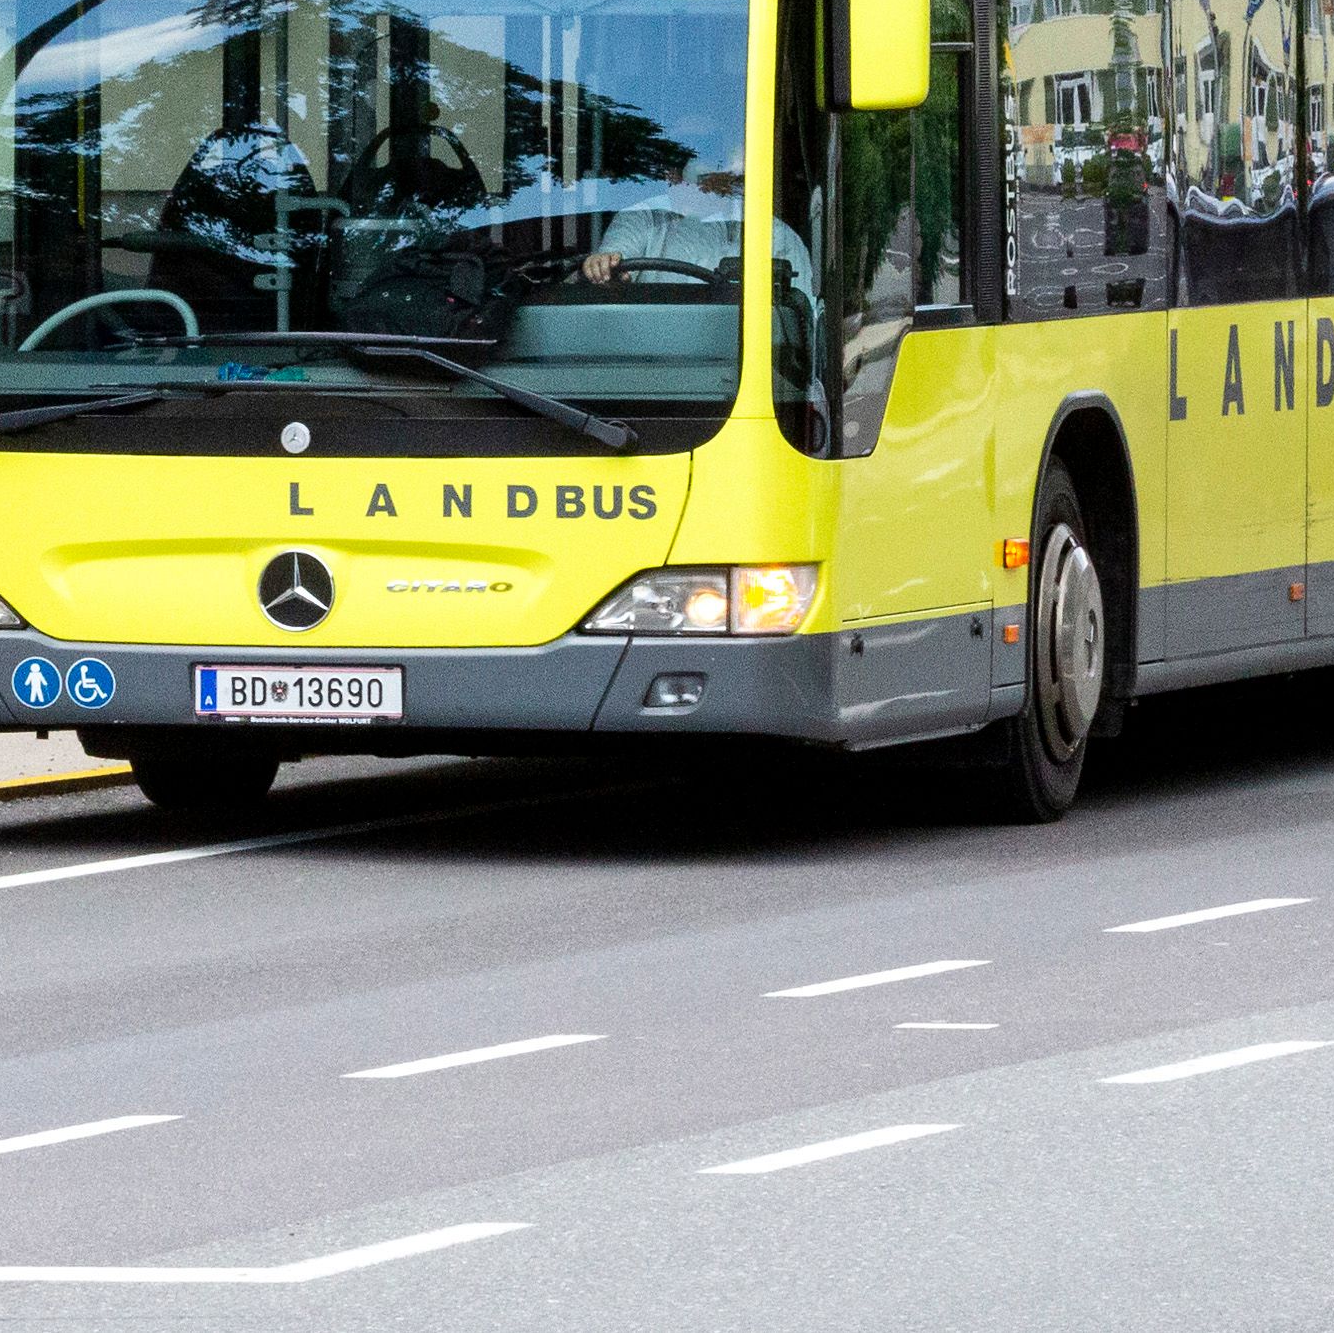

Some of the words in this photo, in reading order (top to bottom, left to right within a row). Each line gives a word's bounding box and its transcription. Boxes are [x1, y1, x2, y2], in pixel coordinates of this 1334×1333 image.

[289, 481, 658, 521] LANDBUS
[386, 578, 514, 593] CITARO
[204, 694, 215, 707] A
[231, 676, 267, 706] BD
[292, 676, 383, 708] 13690
